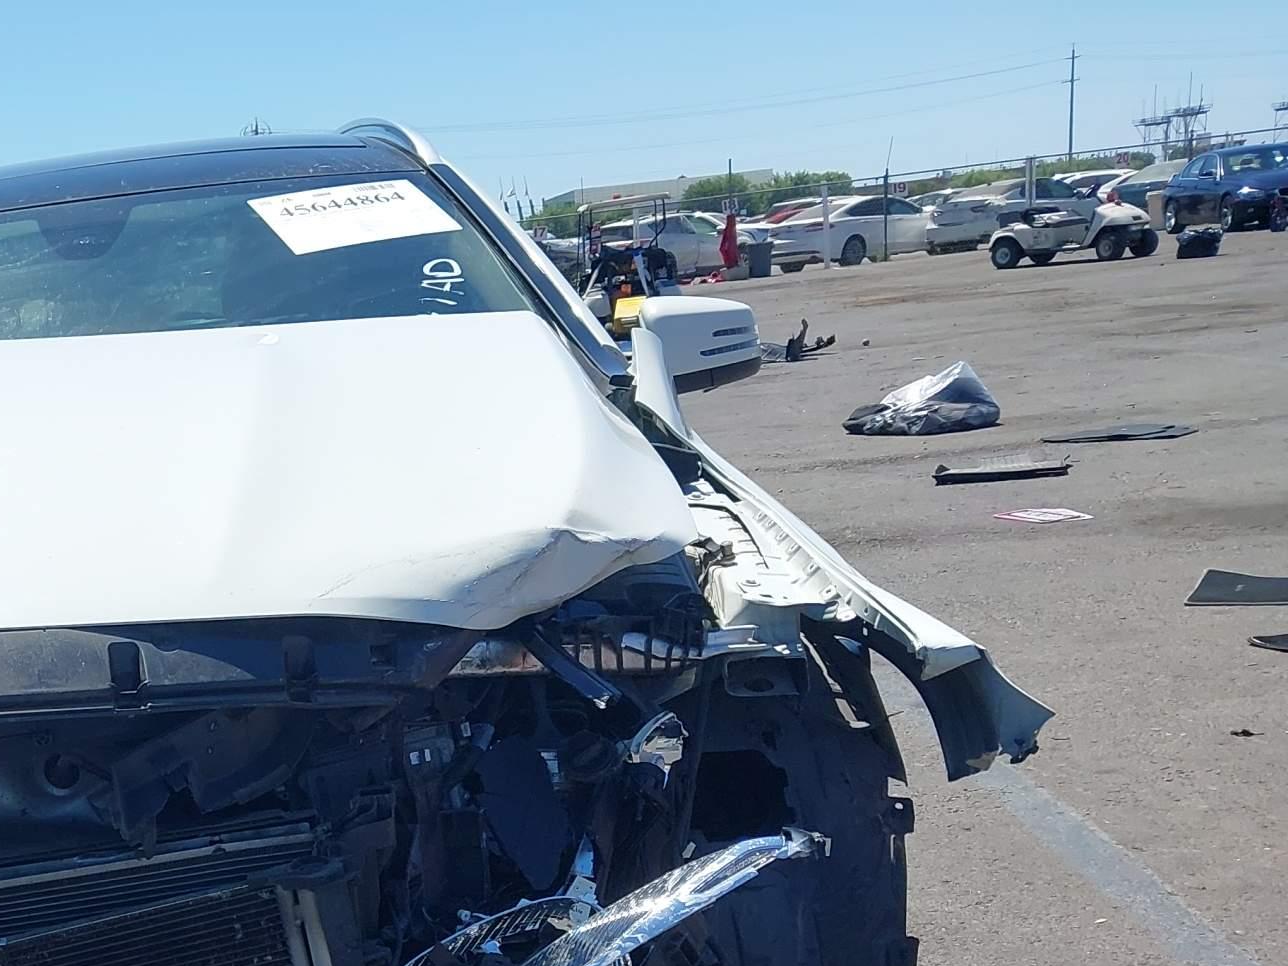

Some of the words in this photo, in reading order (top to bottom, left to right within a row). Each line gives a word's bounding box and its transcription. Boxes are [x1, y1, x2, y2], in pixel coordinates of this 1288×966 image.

[1116, 152, 1129, 164] 20
[893, 182, 906, 193] 19
[280, 191, 406, 216] 45644864
[534, 227, 547, 238] 17
